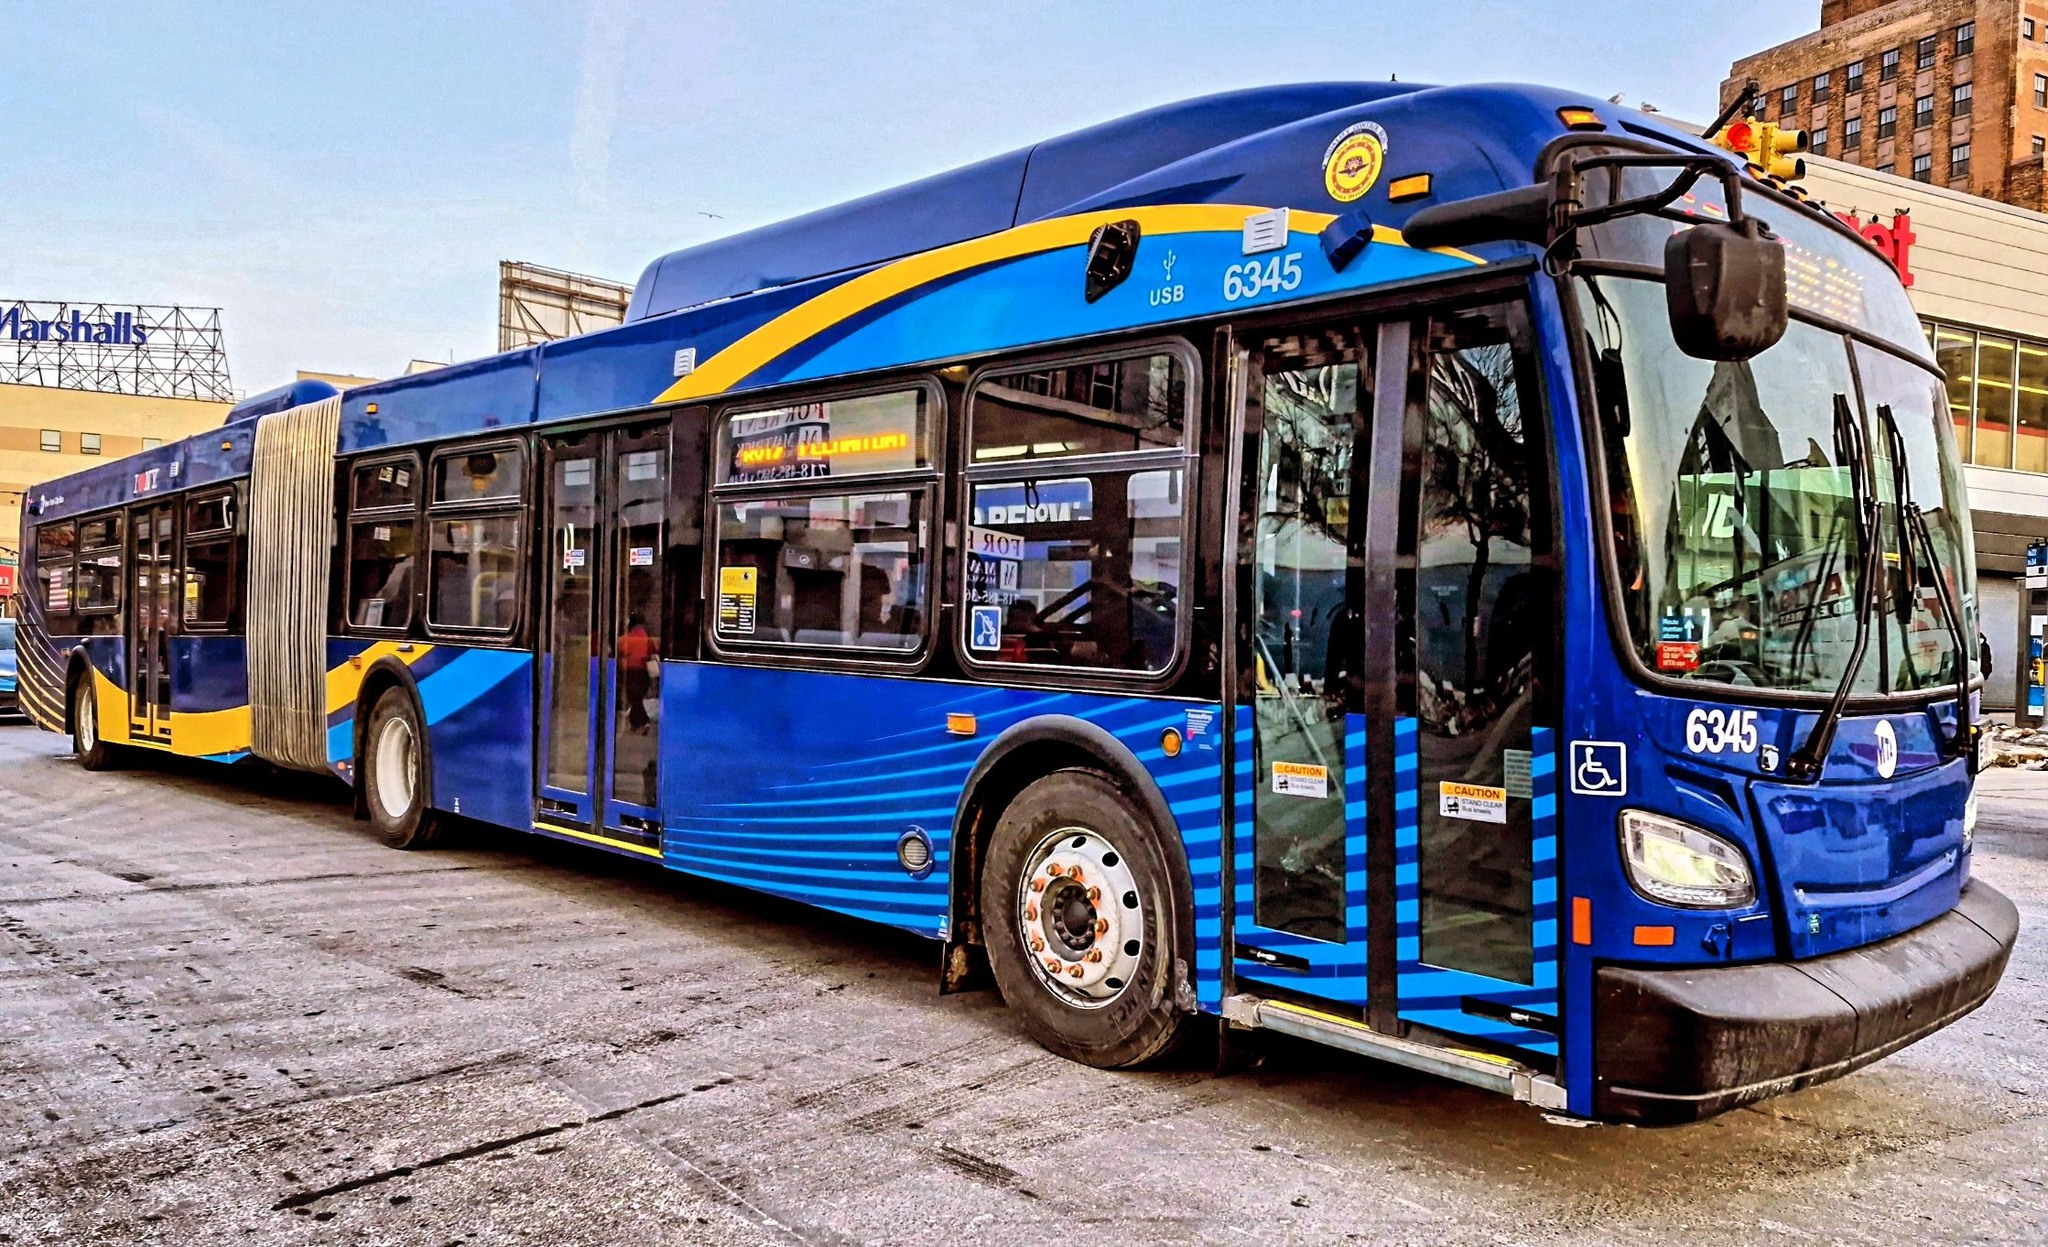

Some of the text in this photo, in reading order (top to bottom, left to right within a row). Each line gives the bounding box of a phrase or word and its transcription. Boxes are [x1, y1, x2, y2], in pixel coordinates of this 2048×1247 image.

[1223, 252, 1303, 302] 6345
[1150, 285, 1185, 307] USB
[0, 307, 147, 346] Marshalls
[145, 468, 159, 492] NY
[1686, 708, 1758, 754] 6345
[1284, 765, 1322, 776] CAUTION
[1454, 786, 1500, 799] CAUTION
[1462, 799, 1503, 809] STAND CLEAR
